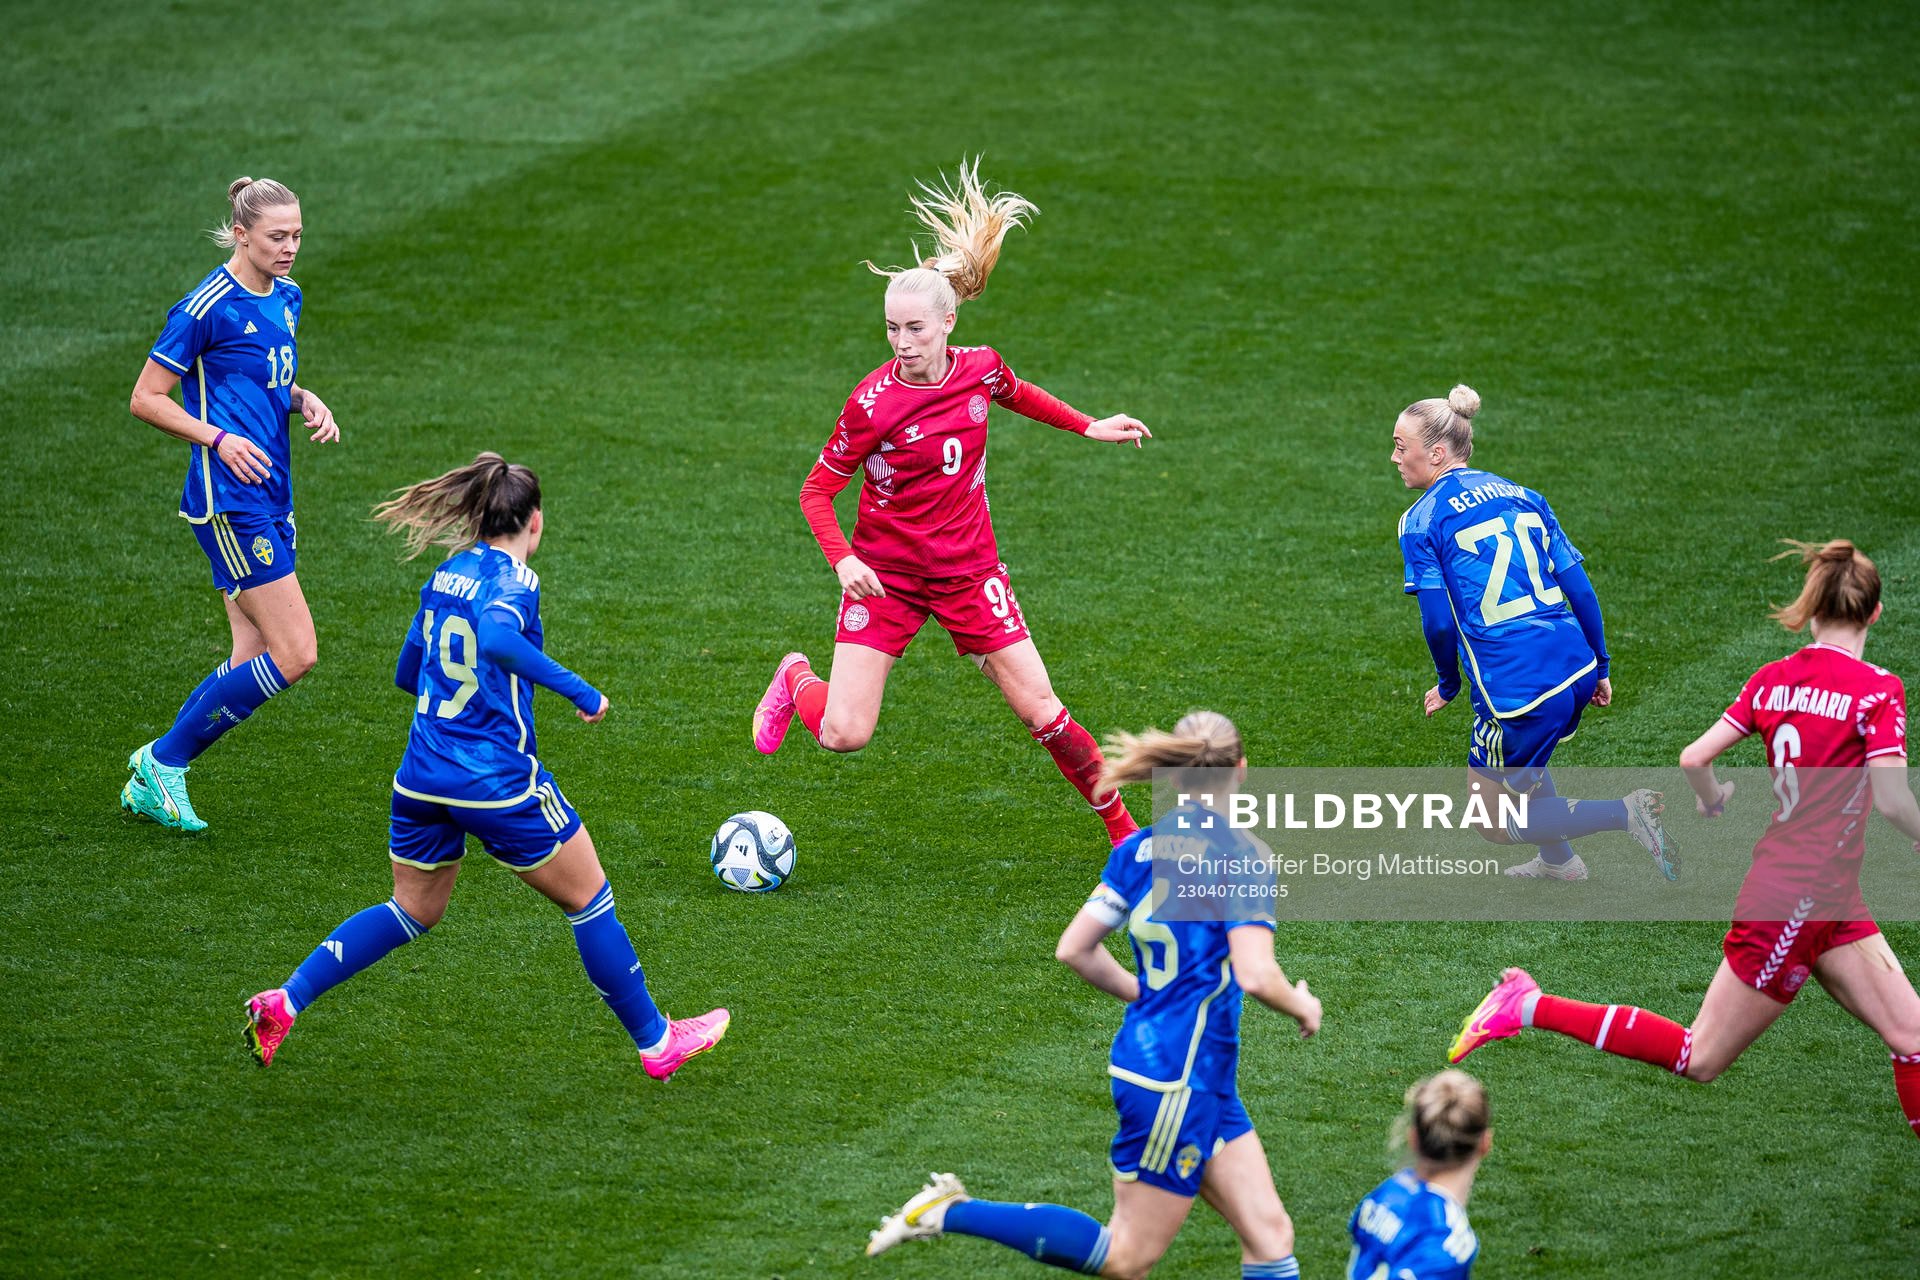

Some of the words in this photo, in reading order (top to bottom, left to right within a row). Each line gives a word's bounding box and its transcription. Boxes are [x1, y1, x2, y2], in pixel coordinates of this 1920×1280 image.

[266, 345, 294, 389] 18
[941, 437, 963, 476] 9
[983, 576, 1009, 618] 9
[1454, 512, 1564, 627] 20
[417, 609, 480, 720] 19
[1772, 722, 1802, 823] 6
[1128, 877, 1179, 992] 6
